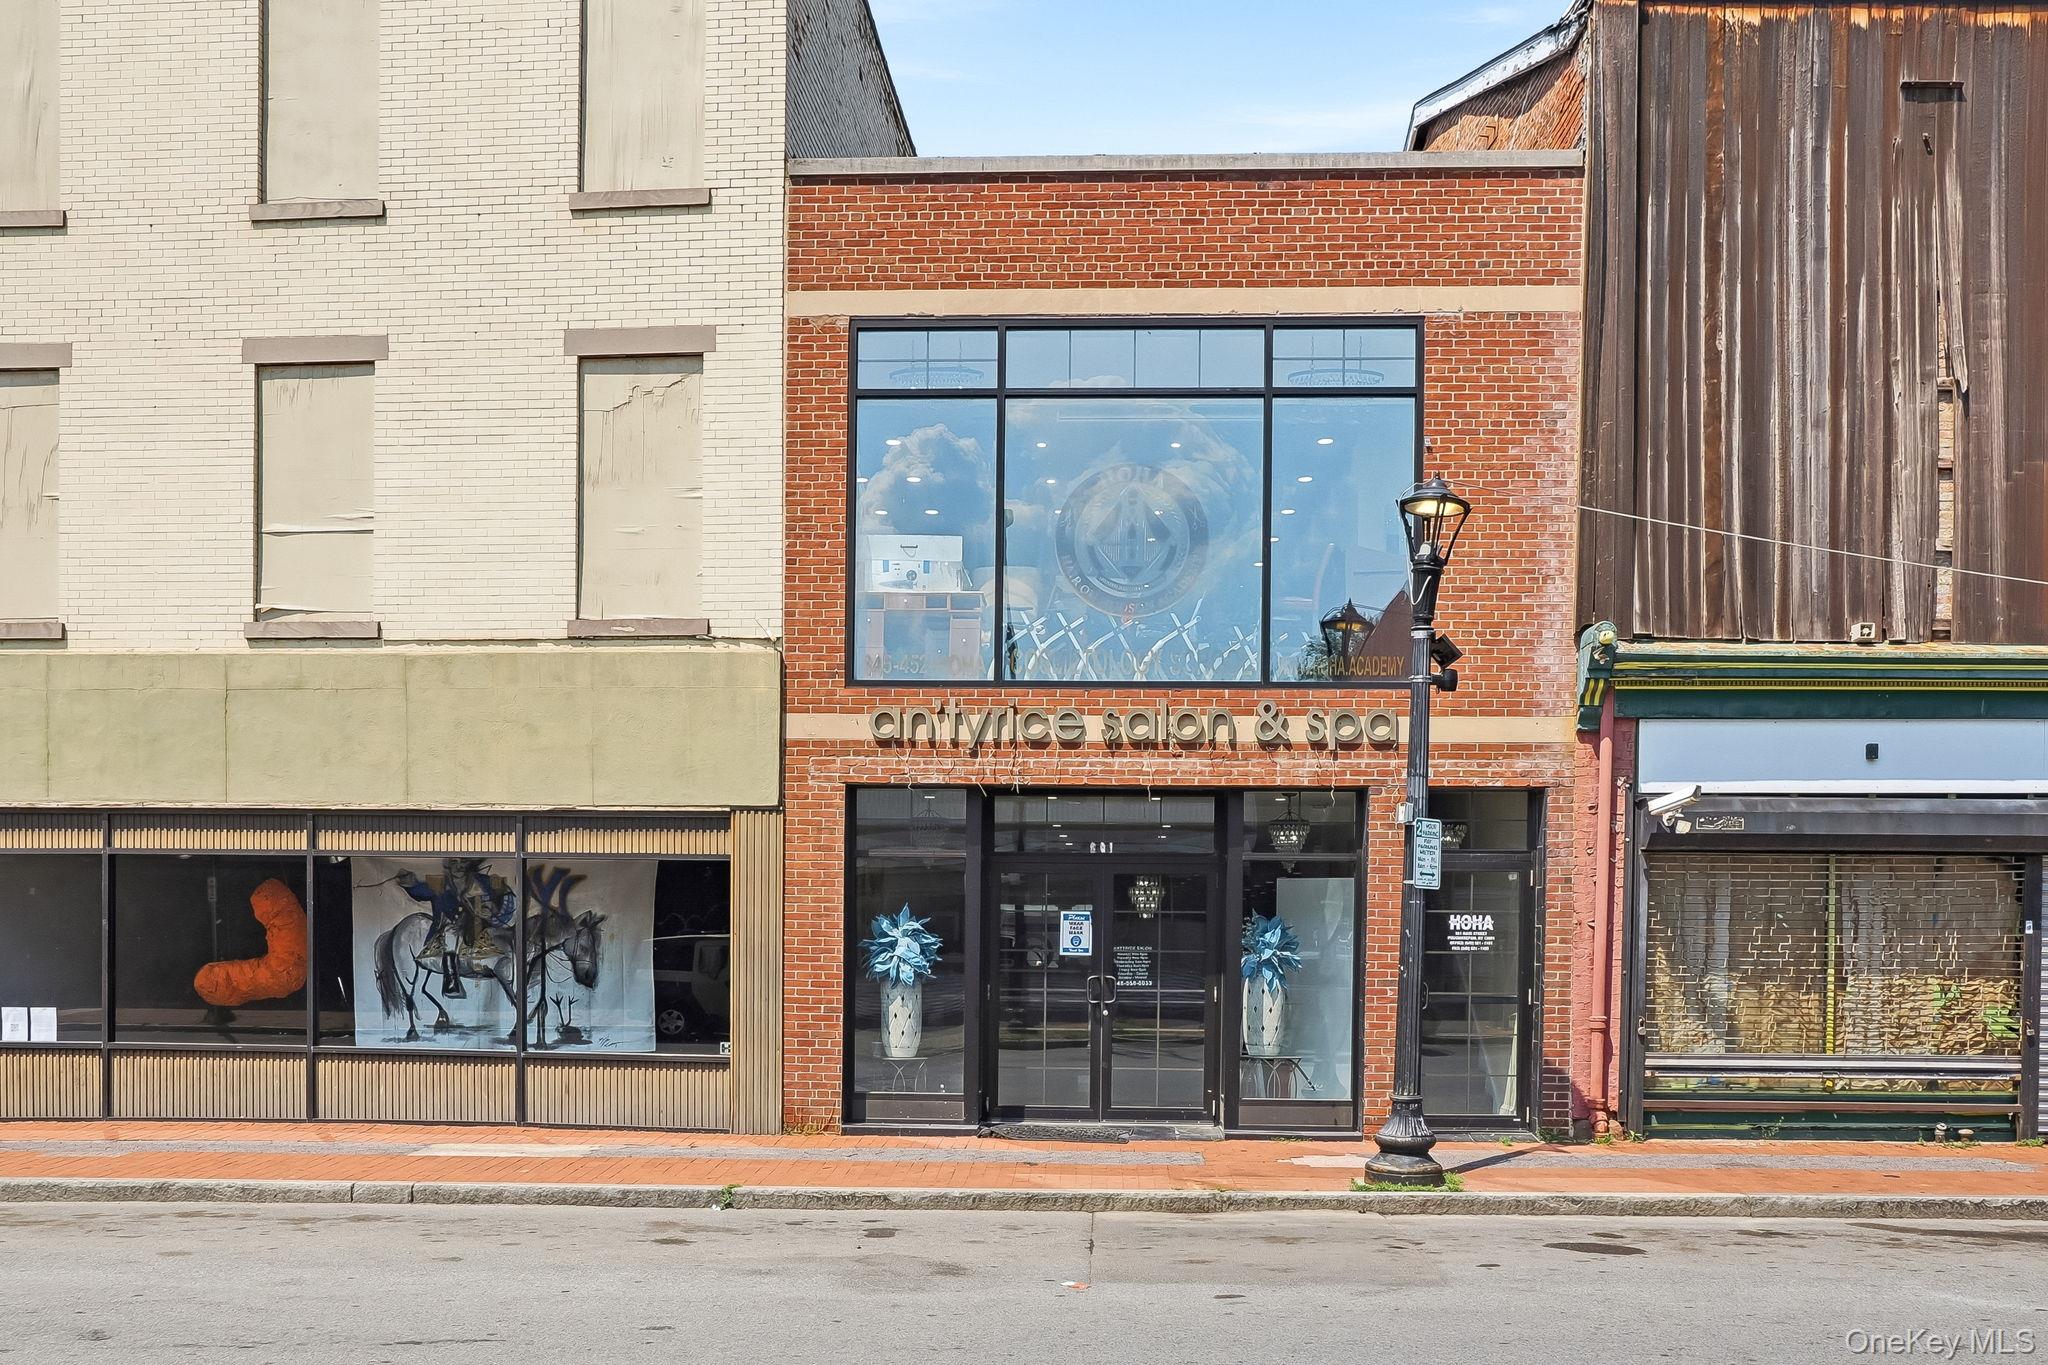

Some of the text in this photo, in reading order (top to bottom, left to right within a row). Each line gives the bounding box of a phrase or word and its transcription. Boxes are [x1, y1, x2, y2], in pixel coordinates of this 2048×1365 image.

[868, 698, 1397, 750] an'tyrice salon & spa
[1416, 821, 1422, 837] 2
[1449, 914, 1494, 931] HOHA
